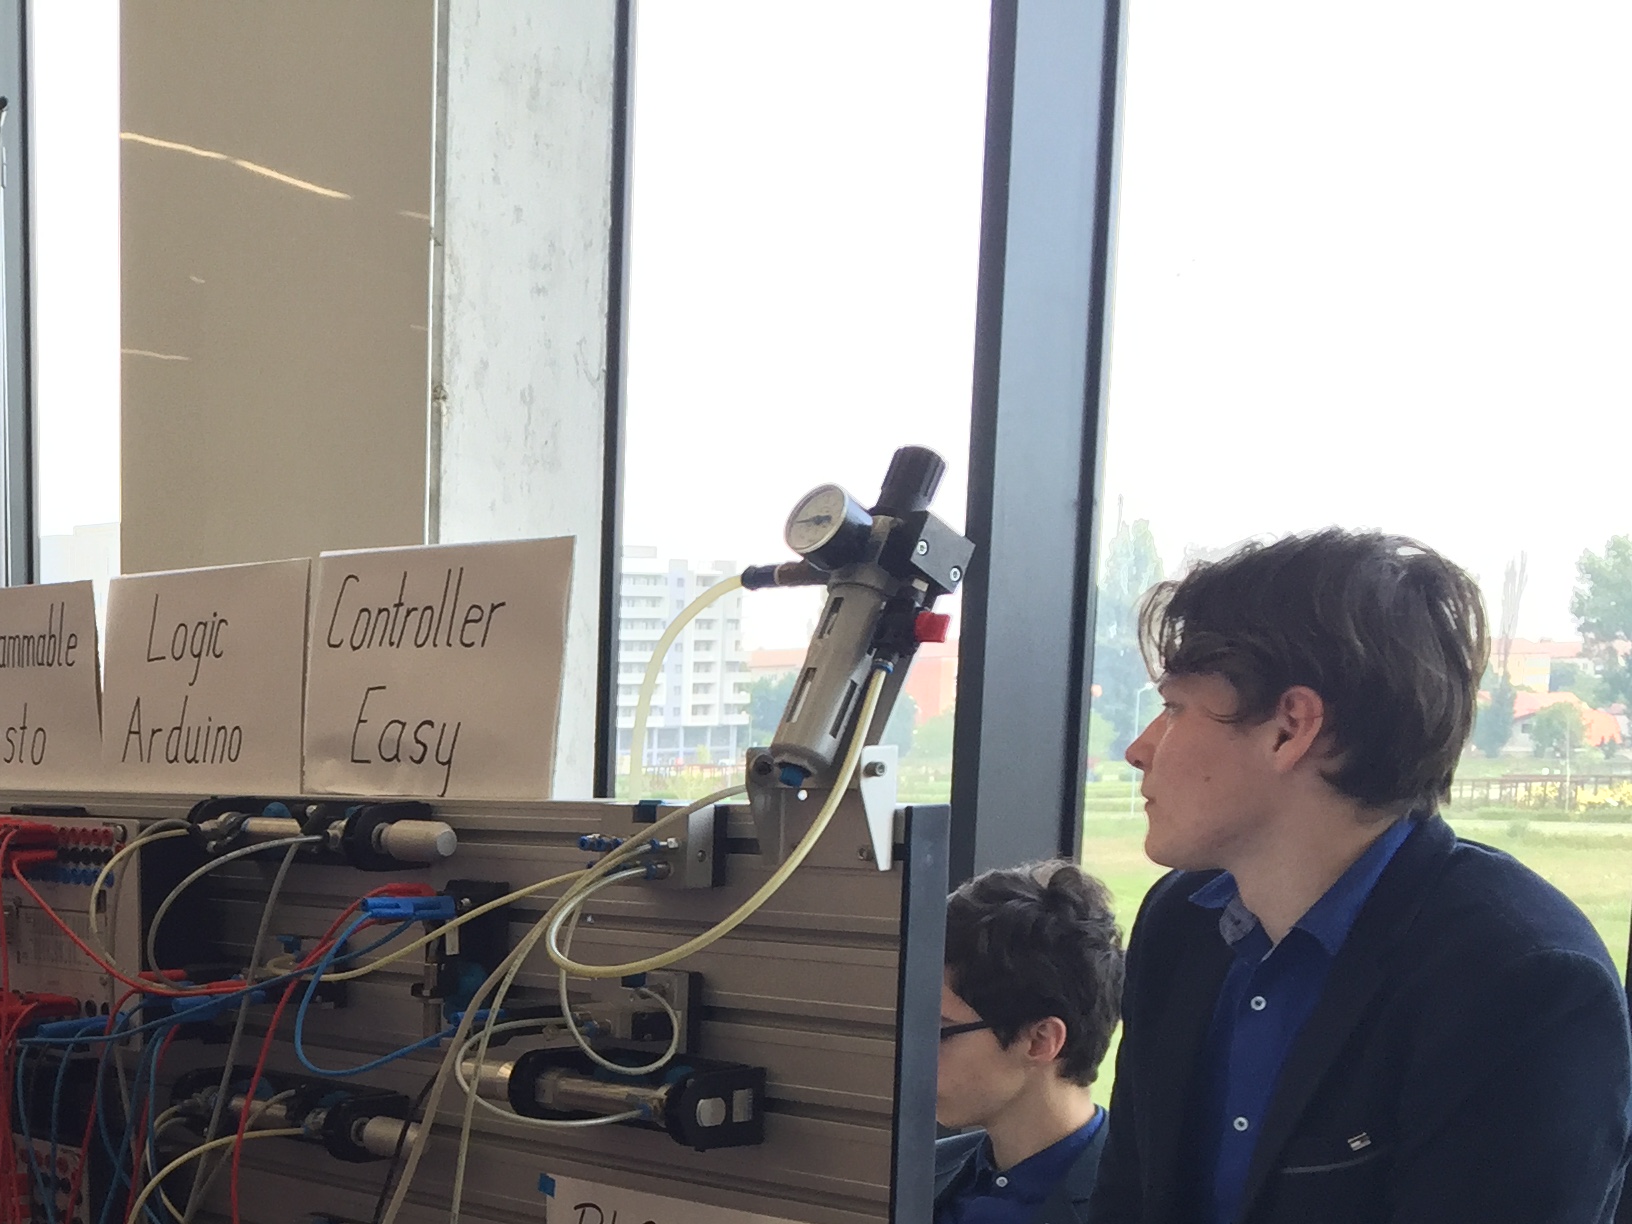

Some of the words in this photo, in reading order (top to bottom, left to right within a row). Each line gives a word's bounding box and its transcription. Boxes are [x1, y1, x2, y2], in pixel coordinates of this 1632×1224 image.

[146, 593, 229, 686] Logic
[326, 566, 507, 651] Controller
[122, 695, 243, 765] Arduino
[350, 685, 462, 798] Easy
